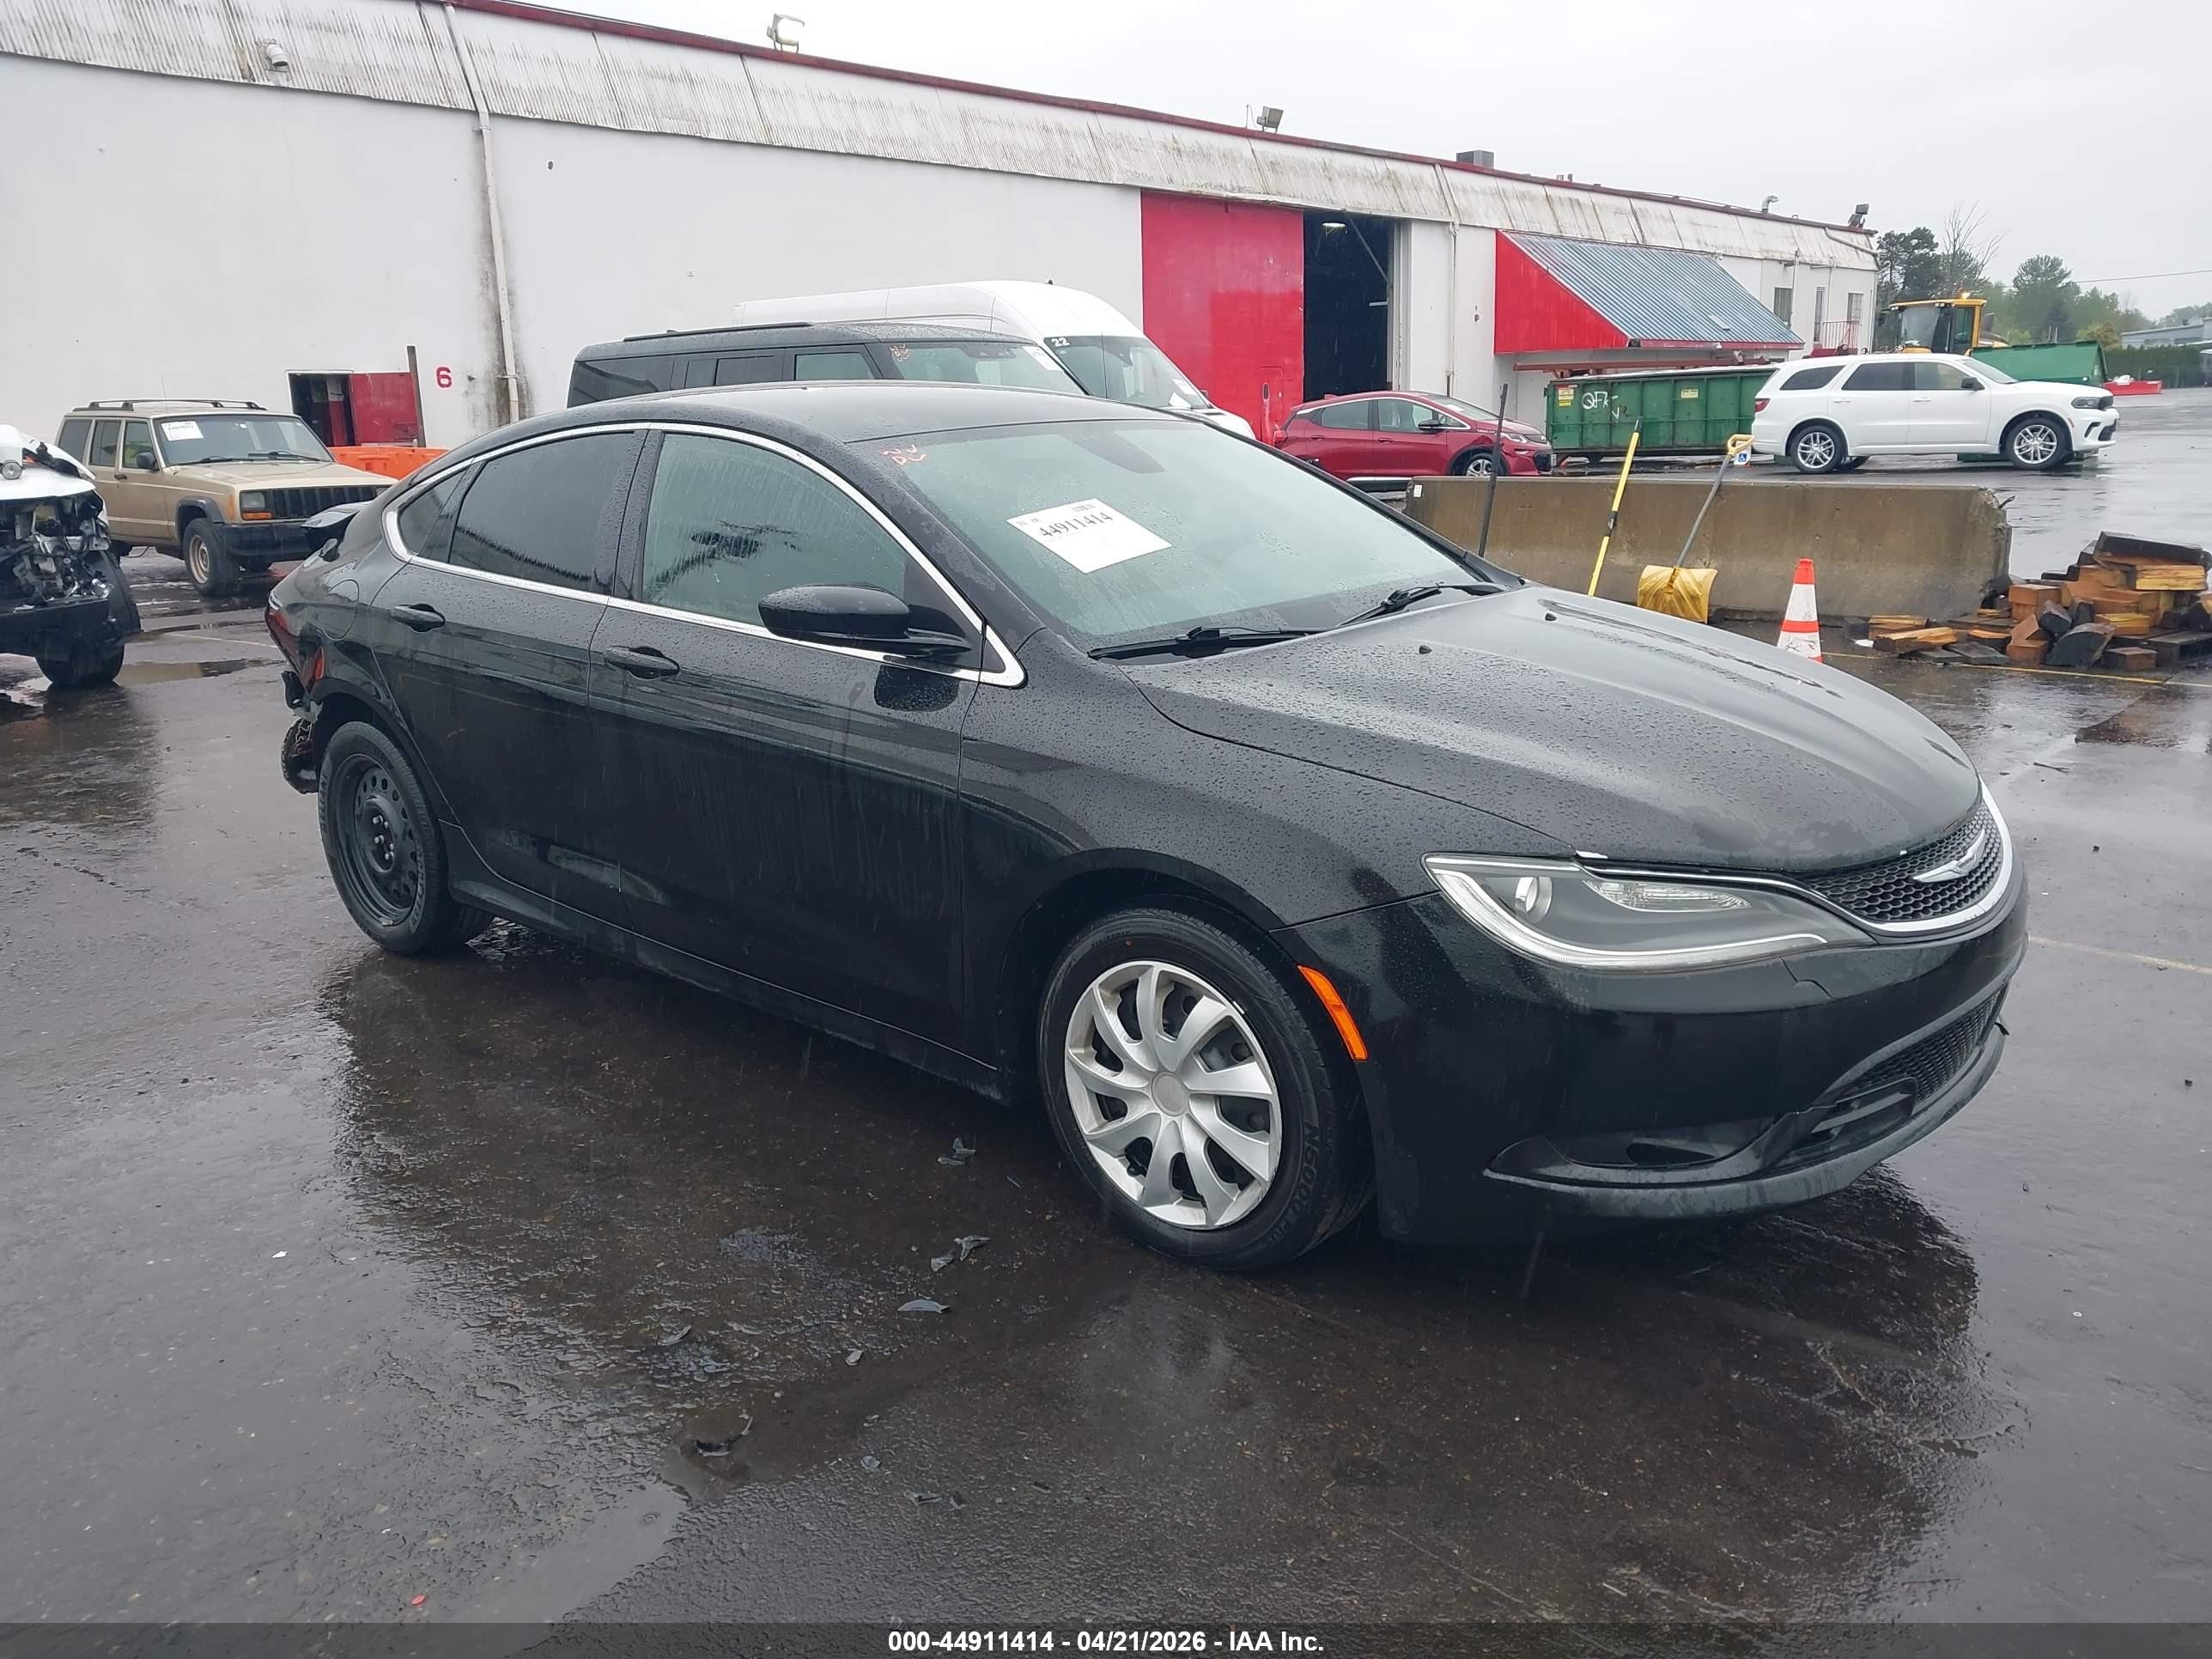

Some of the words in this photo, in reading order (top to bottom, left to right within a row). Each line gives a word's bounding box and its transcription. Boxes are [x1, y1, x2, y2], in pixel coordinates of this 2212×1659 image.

[1050, 337, 1070, 347] 22
[436, 367, 453, 388] 6
[1039, 512, 1114, 538] 44911414
